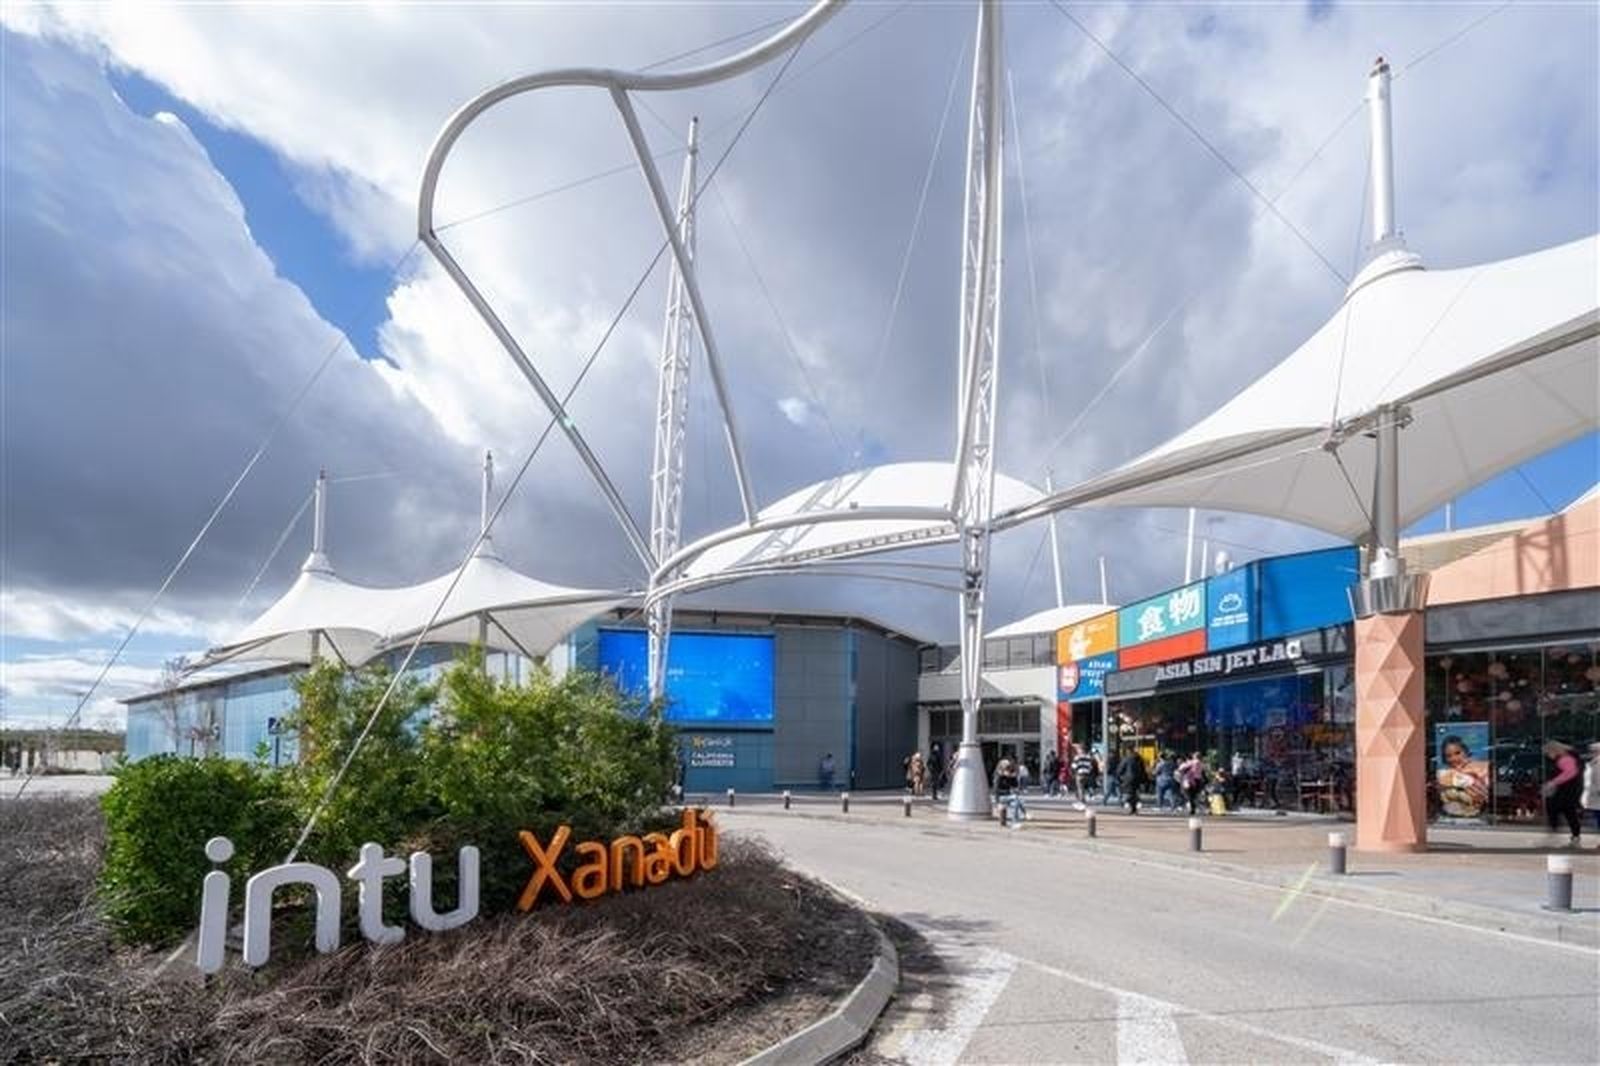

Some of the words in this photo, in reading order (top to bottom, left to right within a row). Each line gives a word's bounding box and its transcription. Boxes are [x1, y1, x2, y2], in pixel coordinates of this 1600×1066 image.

[1155, 661, 1191, 681] ASIA
[1193, 655, 1223, 674] SIN
[1225, 649, 1257, 674] JET
[197, 836, 480, 974] intu
